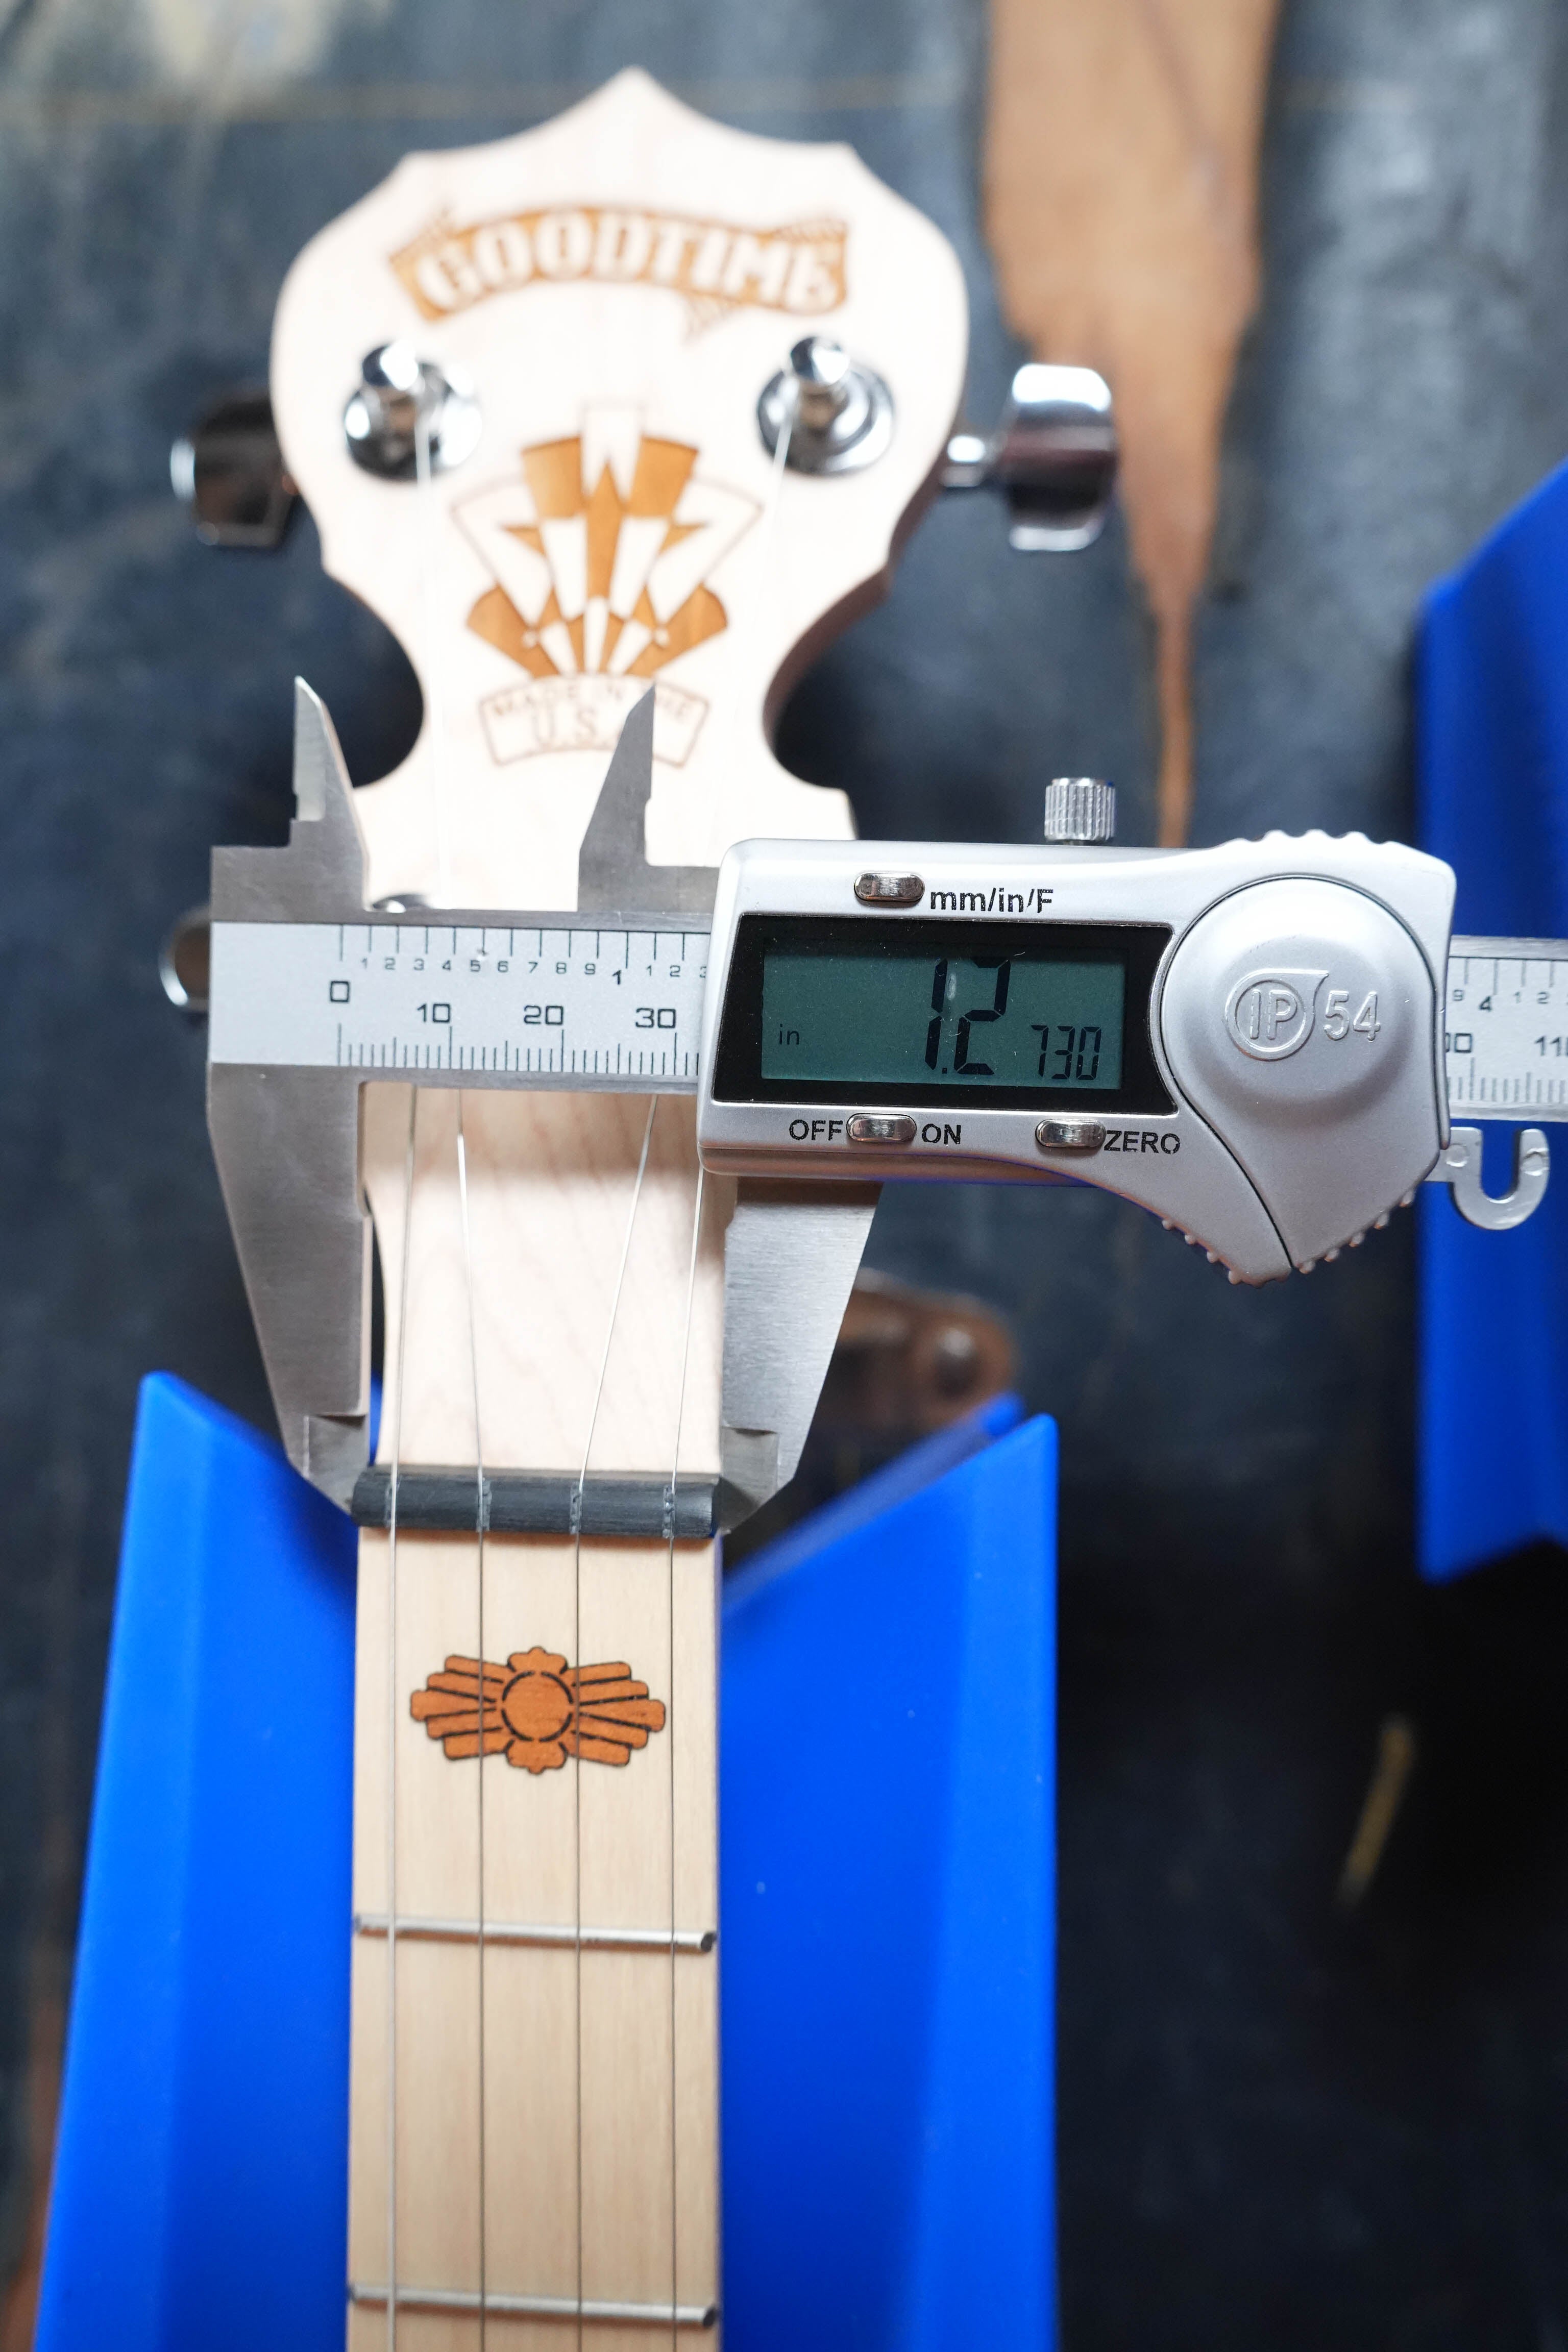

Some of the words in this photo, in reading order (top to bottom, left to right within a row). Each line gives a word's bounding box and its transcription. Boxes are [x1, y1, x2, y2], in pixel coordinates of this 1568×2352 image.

[414, 209, 839, 311] GOODTIME
[930, 888, 1054, 914] mm/in/F
[361, 958, 368, 969] 1
[384, 958, 396, 970] 2
[413, 958, 425, 971] 3
[442, 960, 452, 972] 4
[470, 960, 481, 972] 5
[498, 961, 509, 973] 6
[528, 962, 539, 974] 7
[556, 963, 567, 975] 8
[584, 963, 596, 975] 9
[612, 970, 622, 986] 1
[646, 965, 652, 977] 1
[670, 965, 681, 977] 2
[1479, 996, 1492, 1012] 4
[1513, 992, 1521, 1004] 1
[1537, 992, 1550, 1004] 2
[416, 1003, 452, 1023] 10
[524, 1005, 564, 1025] 20
[635, 1008, 676, 1029] 30
[1249, 989, 1298, 1041] IP
[1324, 990, 1381, 1042] 54
[779, 1024, 800, 1045] in
[789, 1119, 843, 1141] OFF
[921, 1123, 962, 1145] ON
[1104, 1130, 1181, 1155] ZERO
